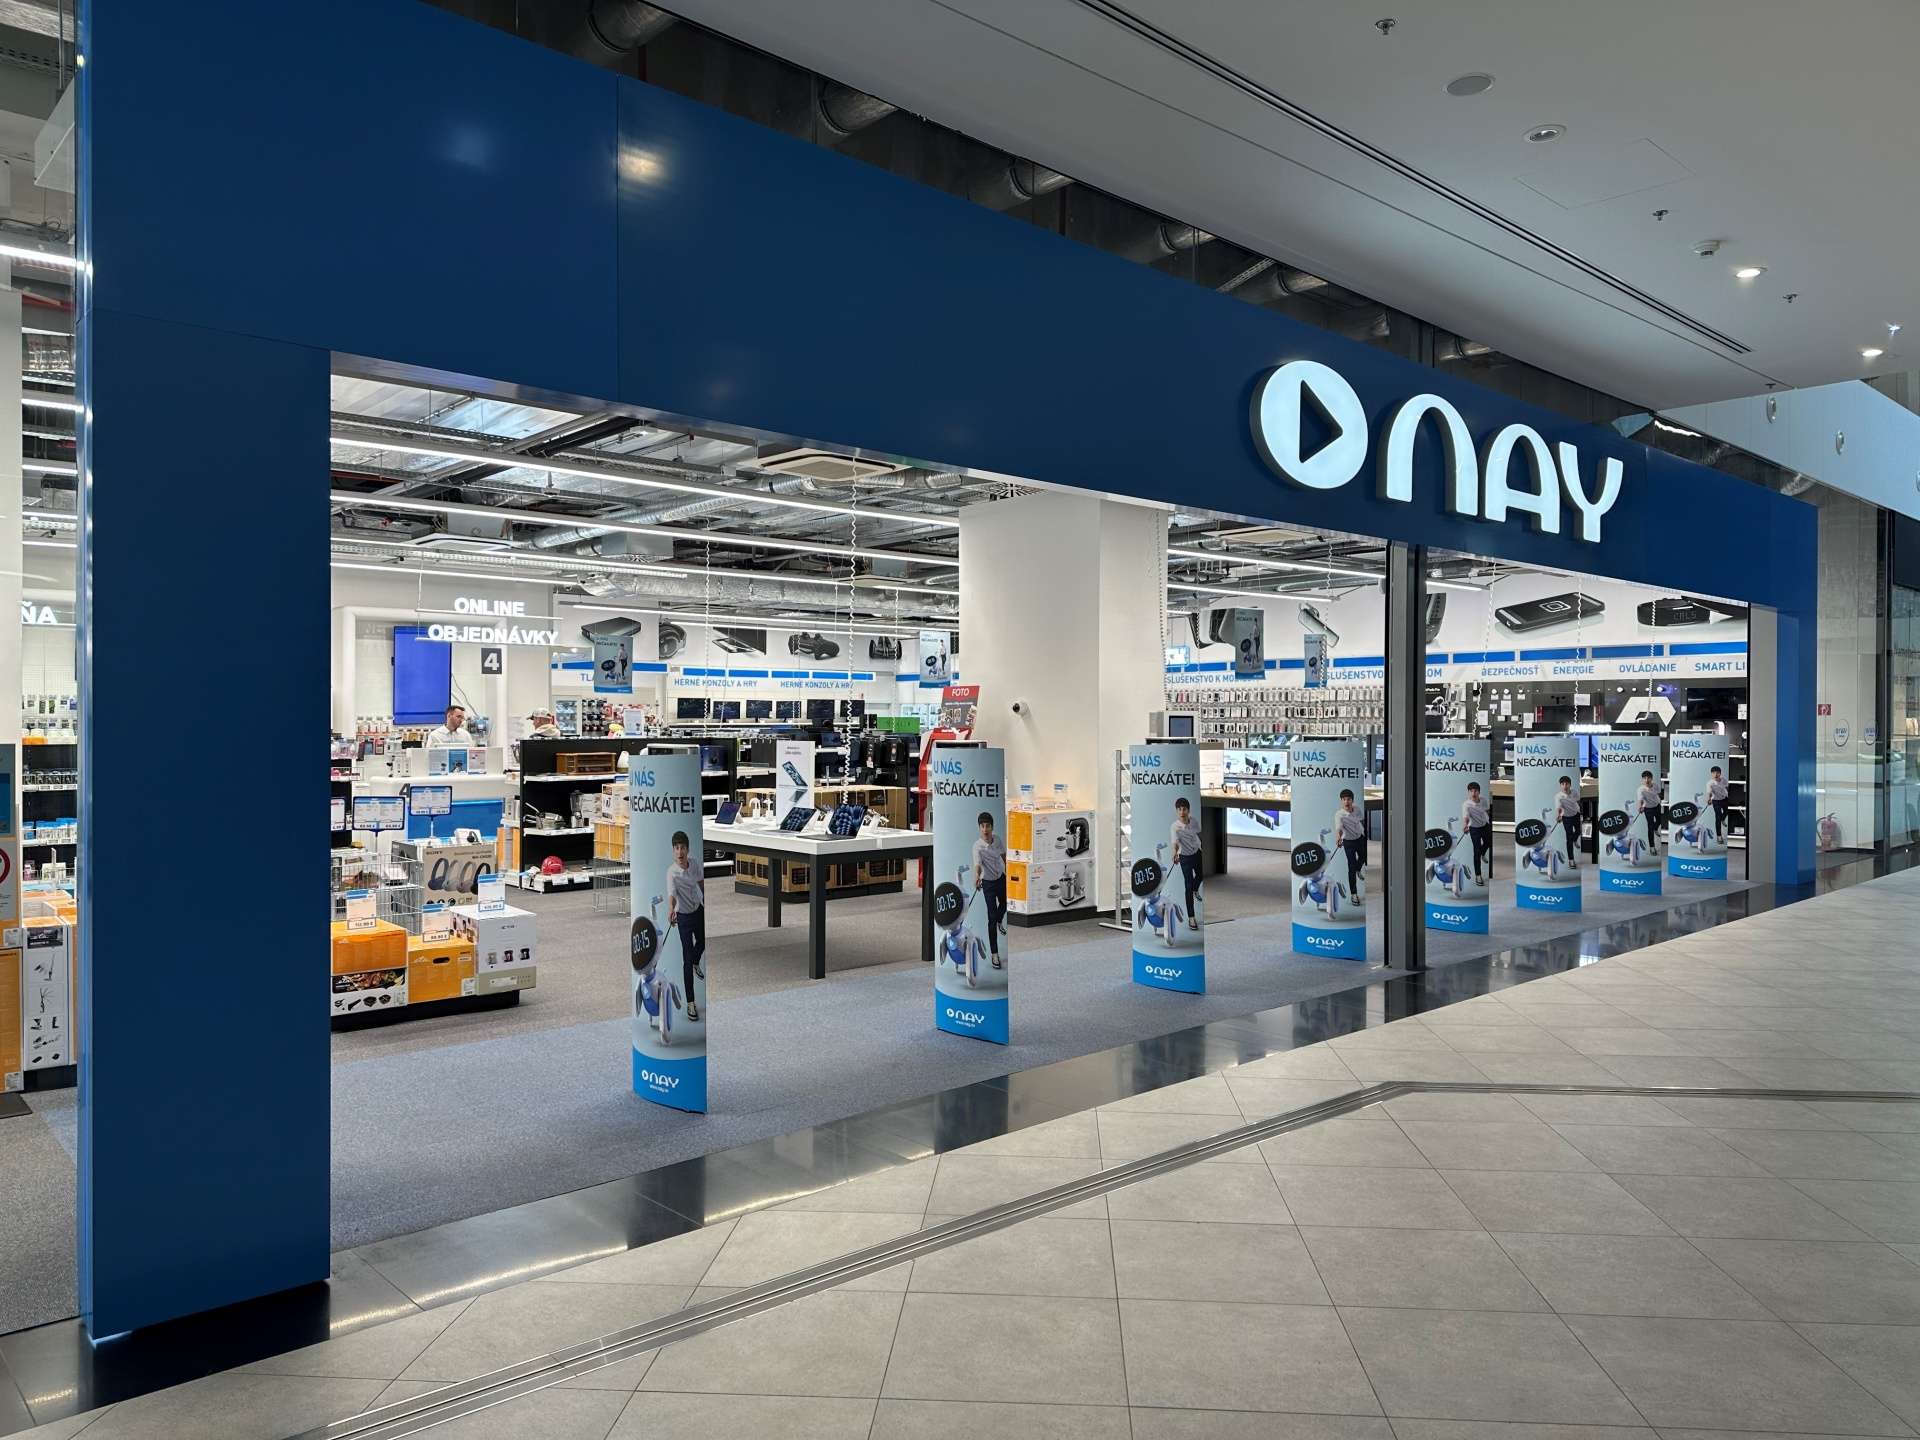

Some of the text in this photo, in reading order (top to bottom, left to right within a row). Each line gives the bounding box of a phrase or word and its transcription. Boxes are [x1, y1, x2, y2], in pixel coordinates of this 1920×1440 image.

[1386, 393, 1624, 543] NAY
[454, 597, 525, 616] ONLINE
[428, 624, 559, 645] OBJEDNÁVKY
[483, 652, 500, 671] 4
[1619, 661, 1677, 673] OVLÁDANIE
[1695, 661, 1733, 672] SMART
[1426, 668, 1442, 678] OM
[1481, 664, 1541, 676] BEZPEČNOSŤ
[1553, 665, 1595, 675] ENERGIE
[580, 673, 594, 682] TL
[702, 679, 735, 688] KONZOLY
[743, 680, 758, 688] HRY
[1215, 674, 1221, 683] K
[805, 681, 833, 689] KONZOLY
[951, 687, 970, 697] FOTO
[1516, 745, 1523, 754] U
[1600, 743, 1607, 751] U
[1672, 739, 1679, 748] U
[1293, 749, 1327, 762] U NÁS
[1431, 745, 1456, 757] NÁS
[1672, 749, 1726, 760] NEČAKÁTE!
[1131, 752, 1161, 767] U NÁS
[1516, 756, 1576, 767] NEČAKÁTE!
[1600, 753, 1657, 764] NEČAKÁTE!
[933, 757, 962, 775] U NÁS
[1293, 764, 1360, 778] NEČAKÁTE!
[1425, 758, 1486, 772] NEČAKÁTE!
[634, 765, 655, 787] NÁS
[1131, 770, 1195, 785] NEČAKÁTE!
[934, 778, 999, 798] NEČAKÁTE!
[629, 791, 695, 813] NEČAKÁTE!
[1672, 806, 1692, 818] 00:15
[1602, 815, 1623, 828] 00:15
[1518, 824, 1541, 839] 00:15
[1295, 849, 1318, 867] 00:15
[1134, 866, 1155, 886] 00:15
[936, 892, 957, 914] 00:15
